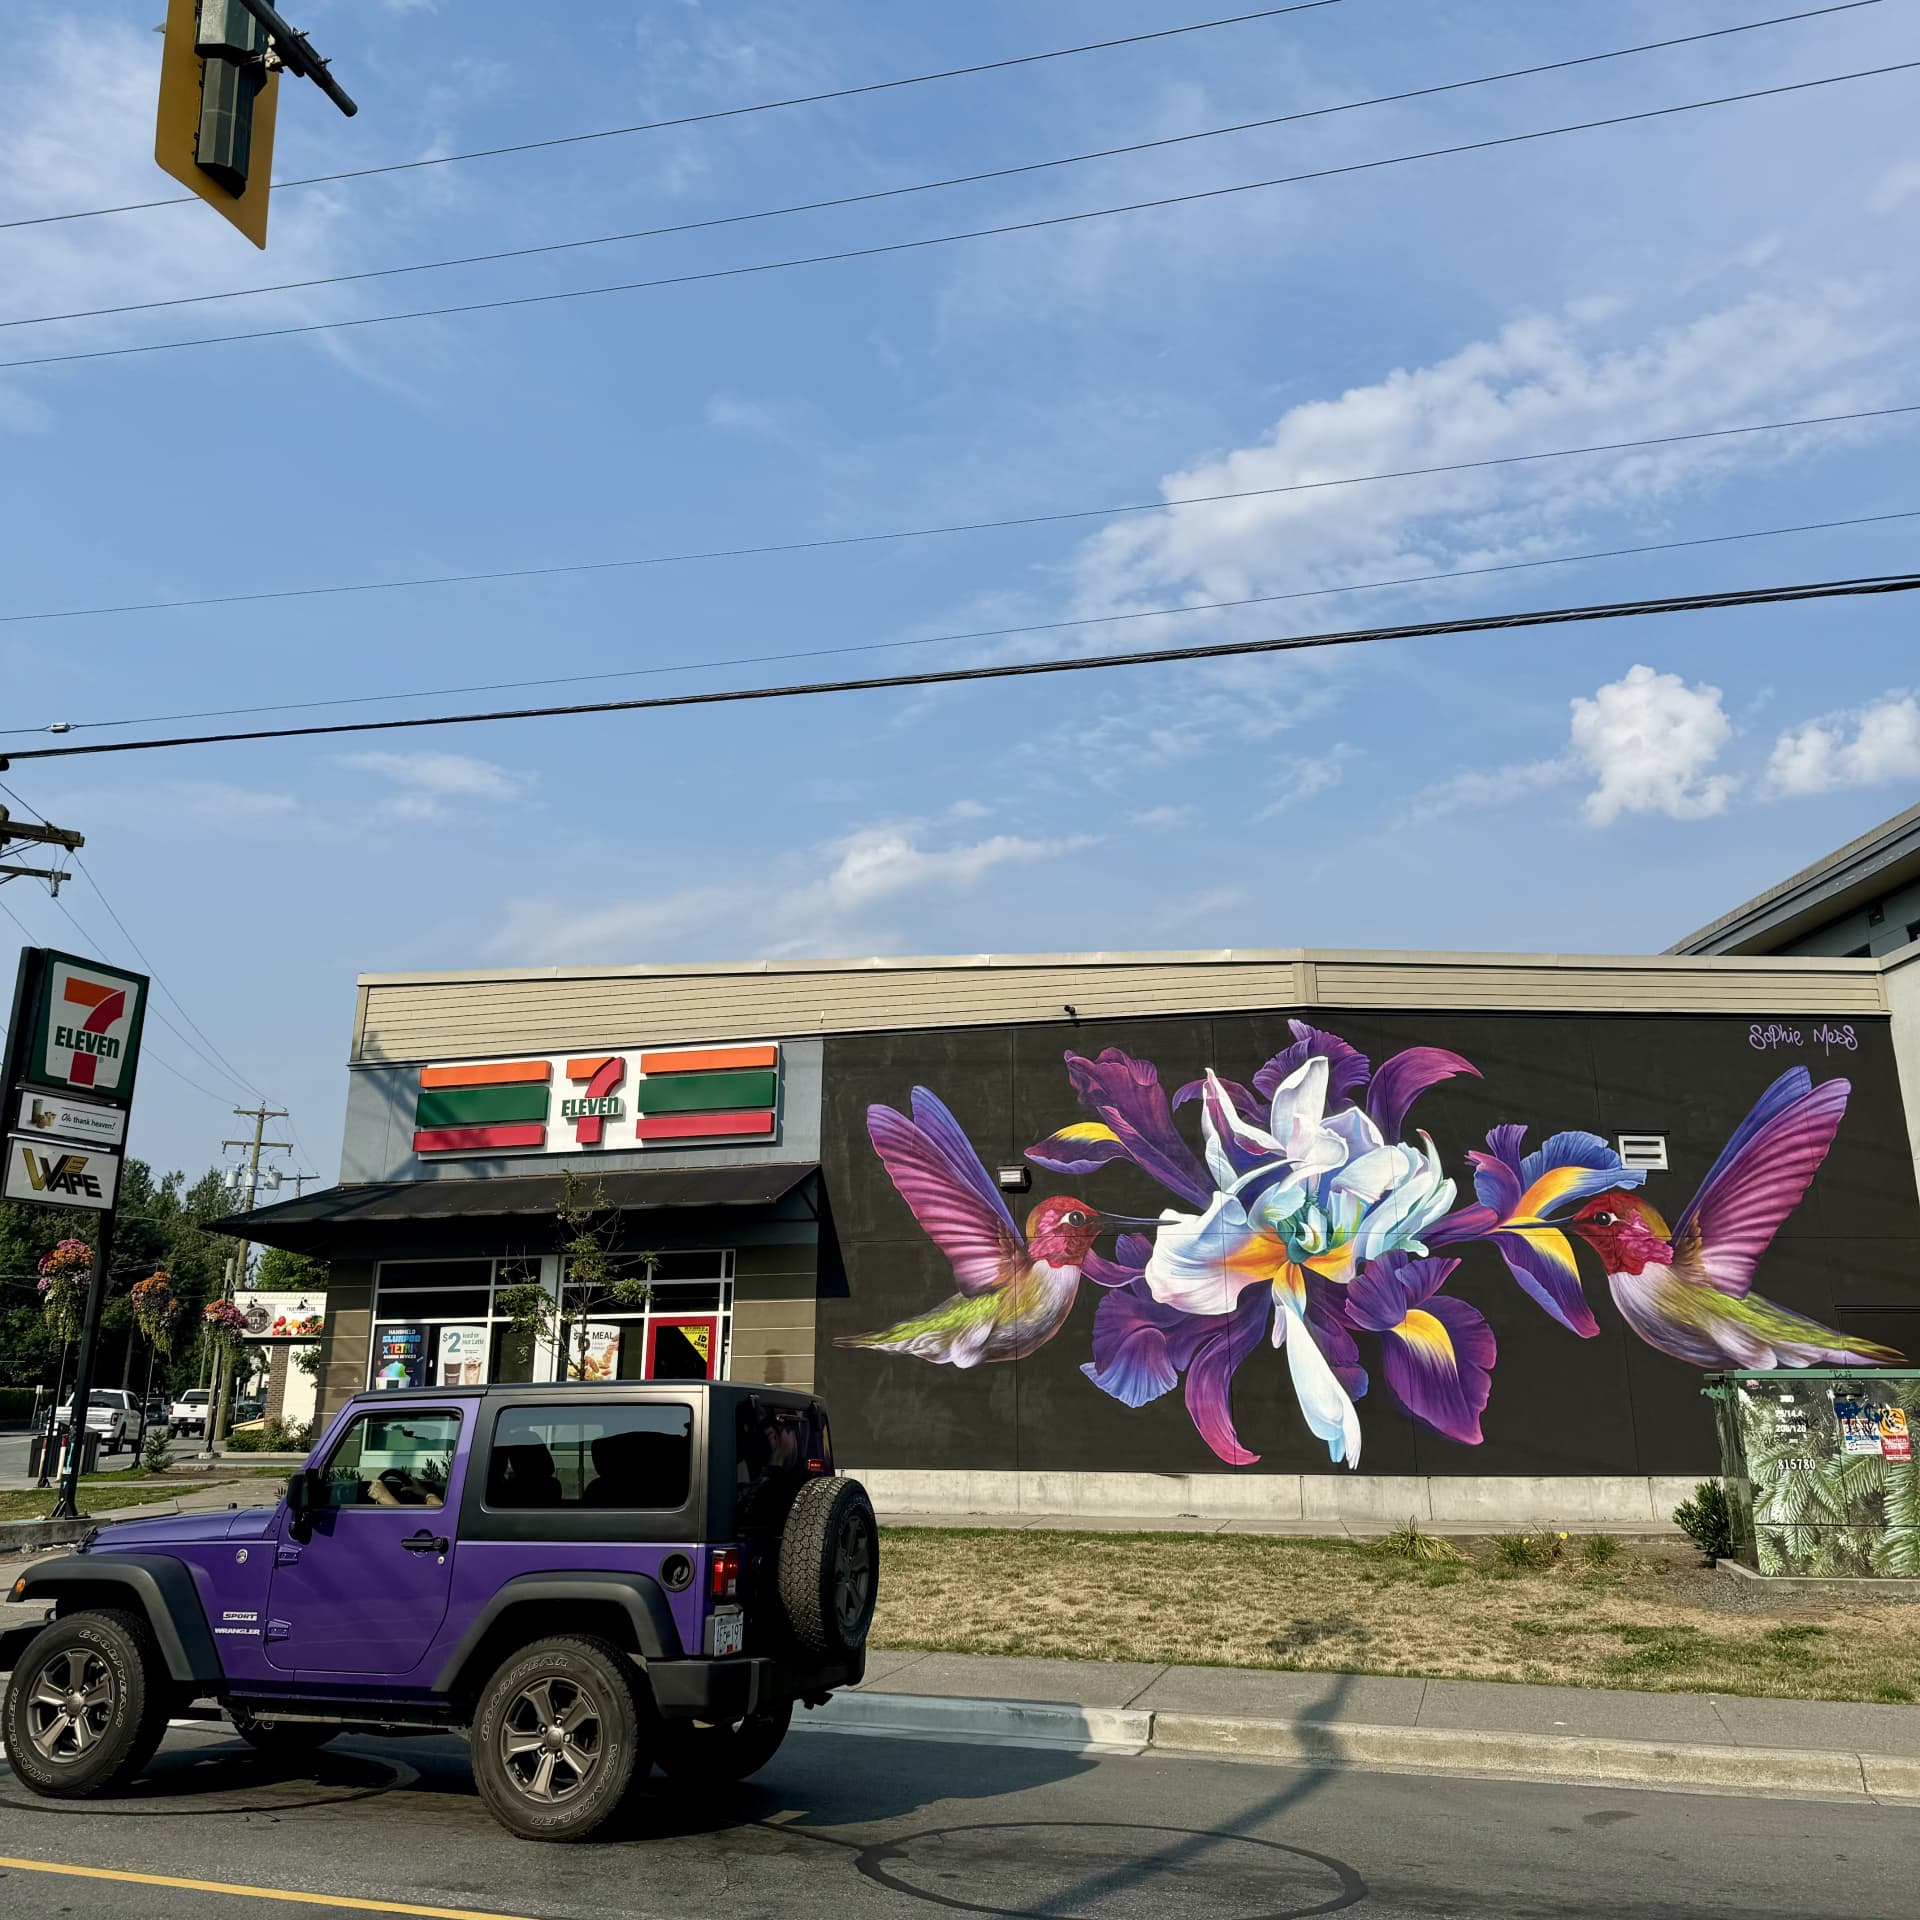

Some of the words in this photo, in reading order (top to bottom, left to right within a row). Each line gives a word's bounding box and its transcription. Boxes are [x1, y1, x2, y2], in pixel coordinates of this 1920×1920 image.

[64, 977, 126, 1086] 7
[566, 1056, 625, 1143] 7
[73, 1116, 90, 1125] thank
[91, 1120, 116, 1130] heaven!
[592, 1331, 614, 1340] MEAL
[697, 1334, 707, 1343] ID
[1777, 1458, 1816, 1470] 815780
[223, 1612, 257, 1620] SPORT
[214, 1627, 261, 1636] WRANGLER
[78, 1629, 127, 1728] GOODYEAR
[481, 1656, 569, 1742] GOODYEAR
